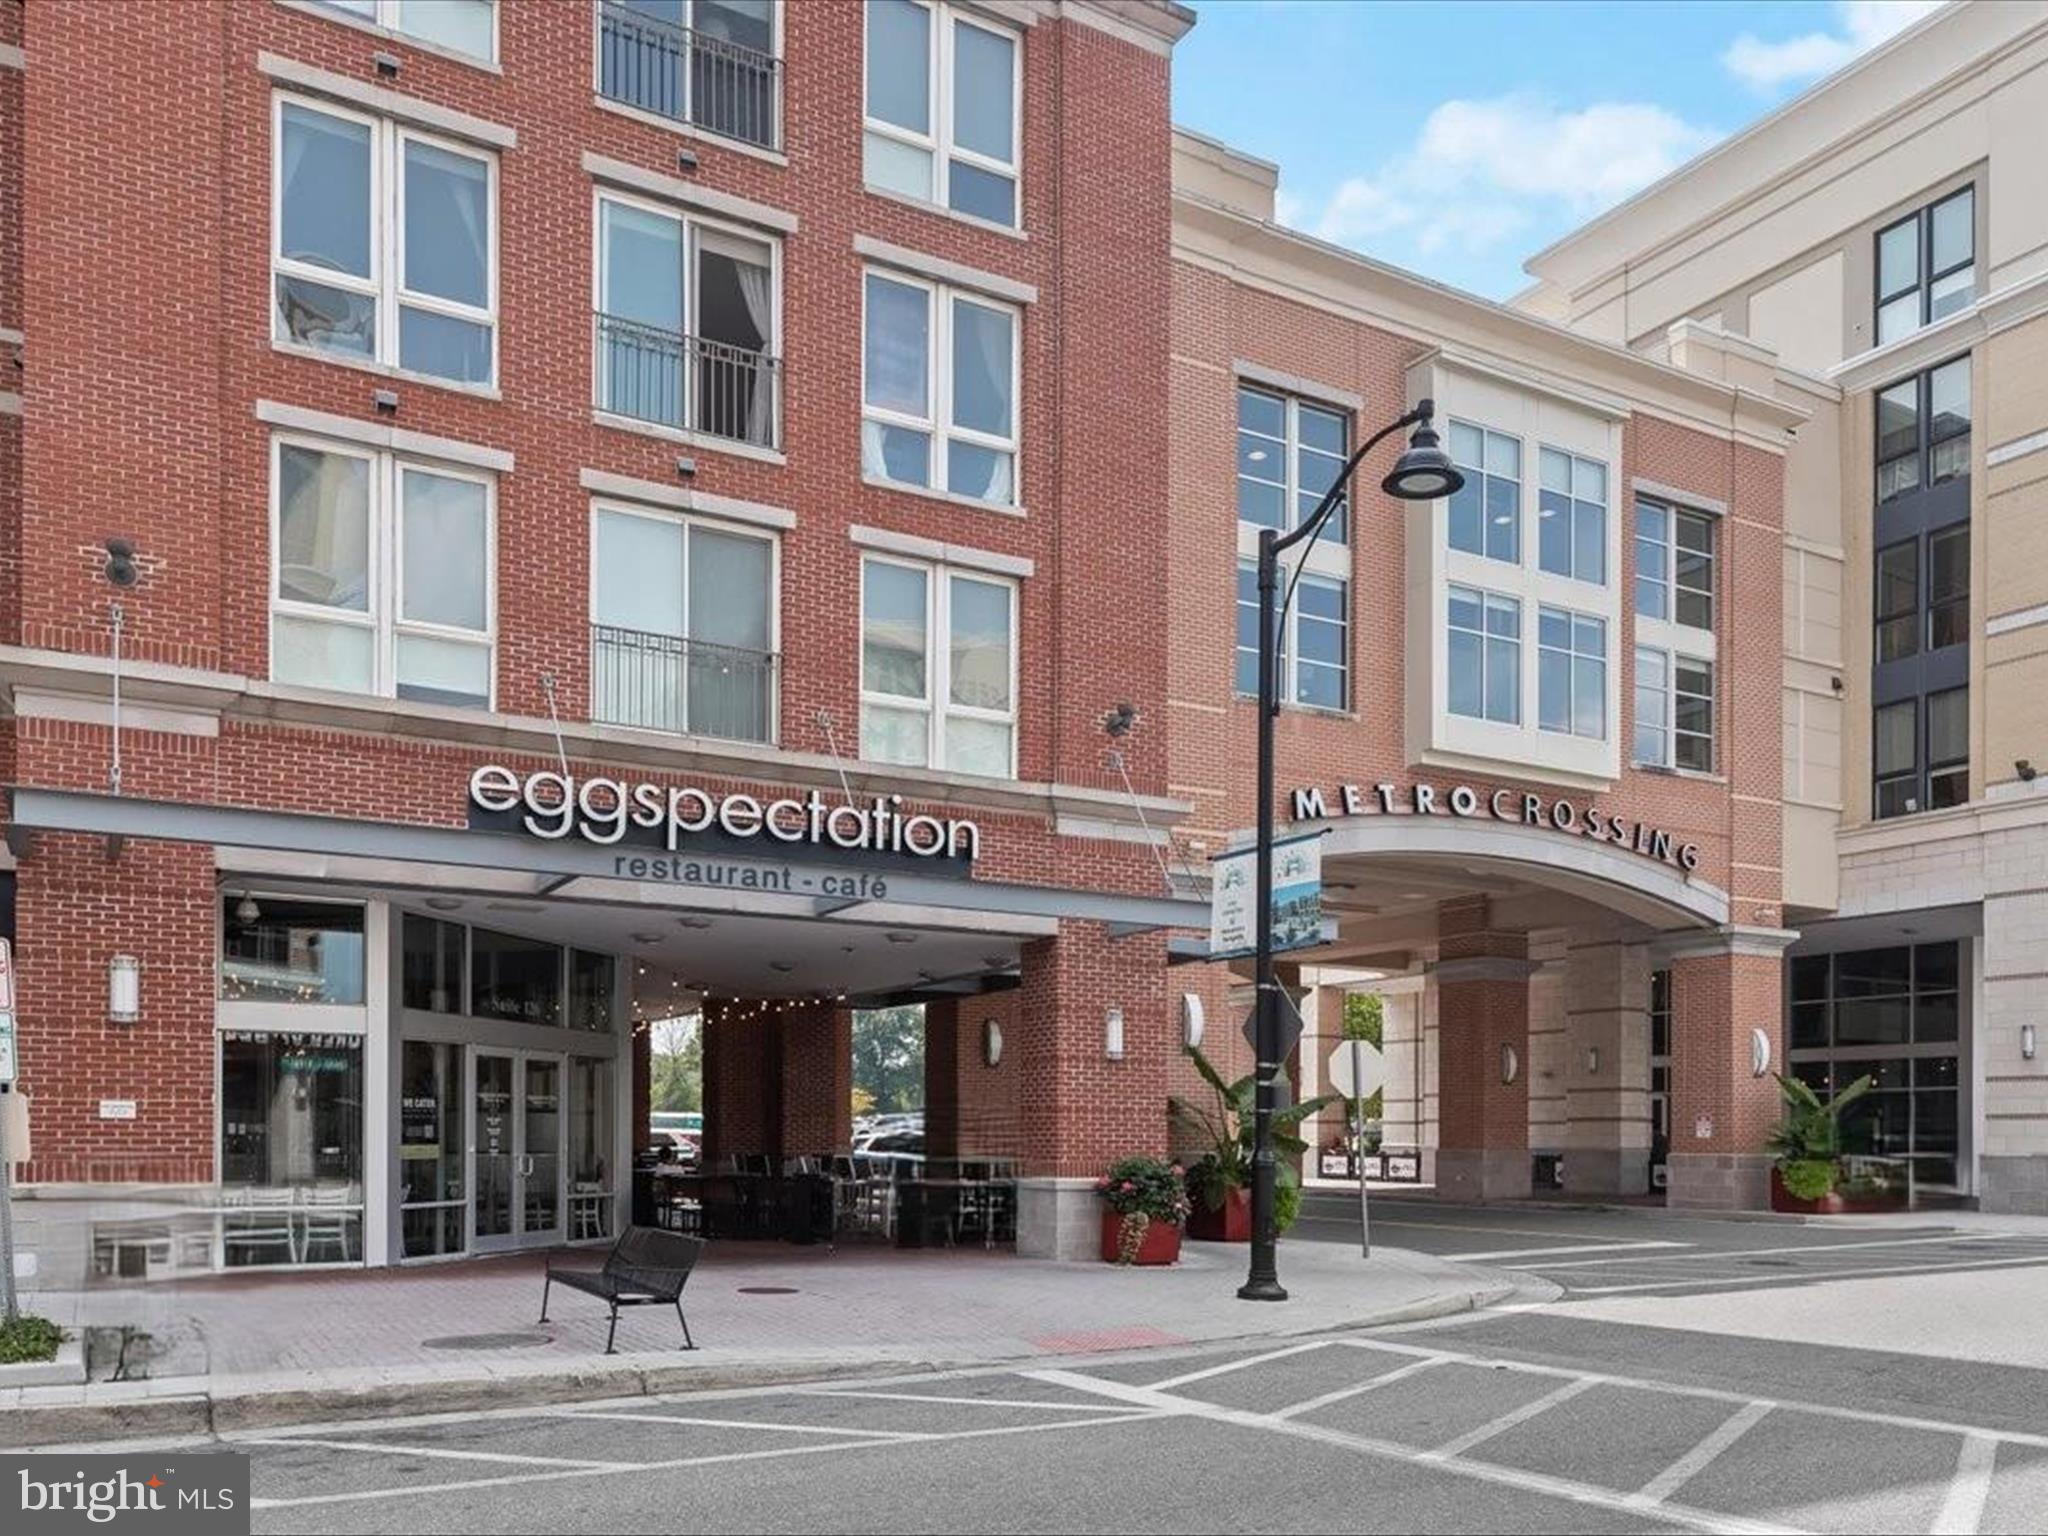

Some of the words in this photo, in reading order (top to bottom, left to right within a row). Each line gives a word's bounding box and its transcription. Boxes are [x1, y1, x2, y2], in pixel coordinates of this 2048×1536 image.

[468, 763, 980, 858] eggspectation
[614, 854, 793, 891] restaurant
[821, 874, 888, 899] café
